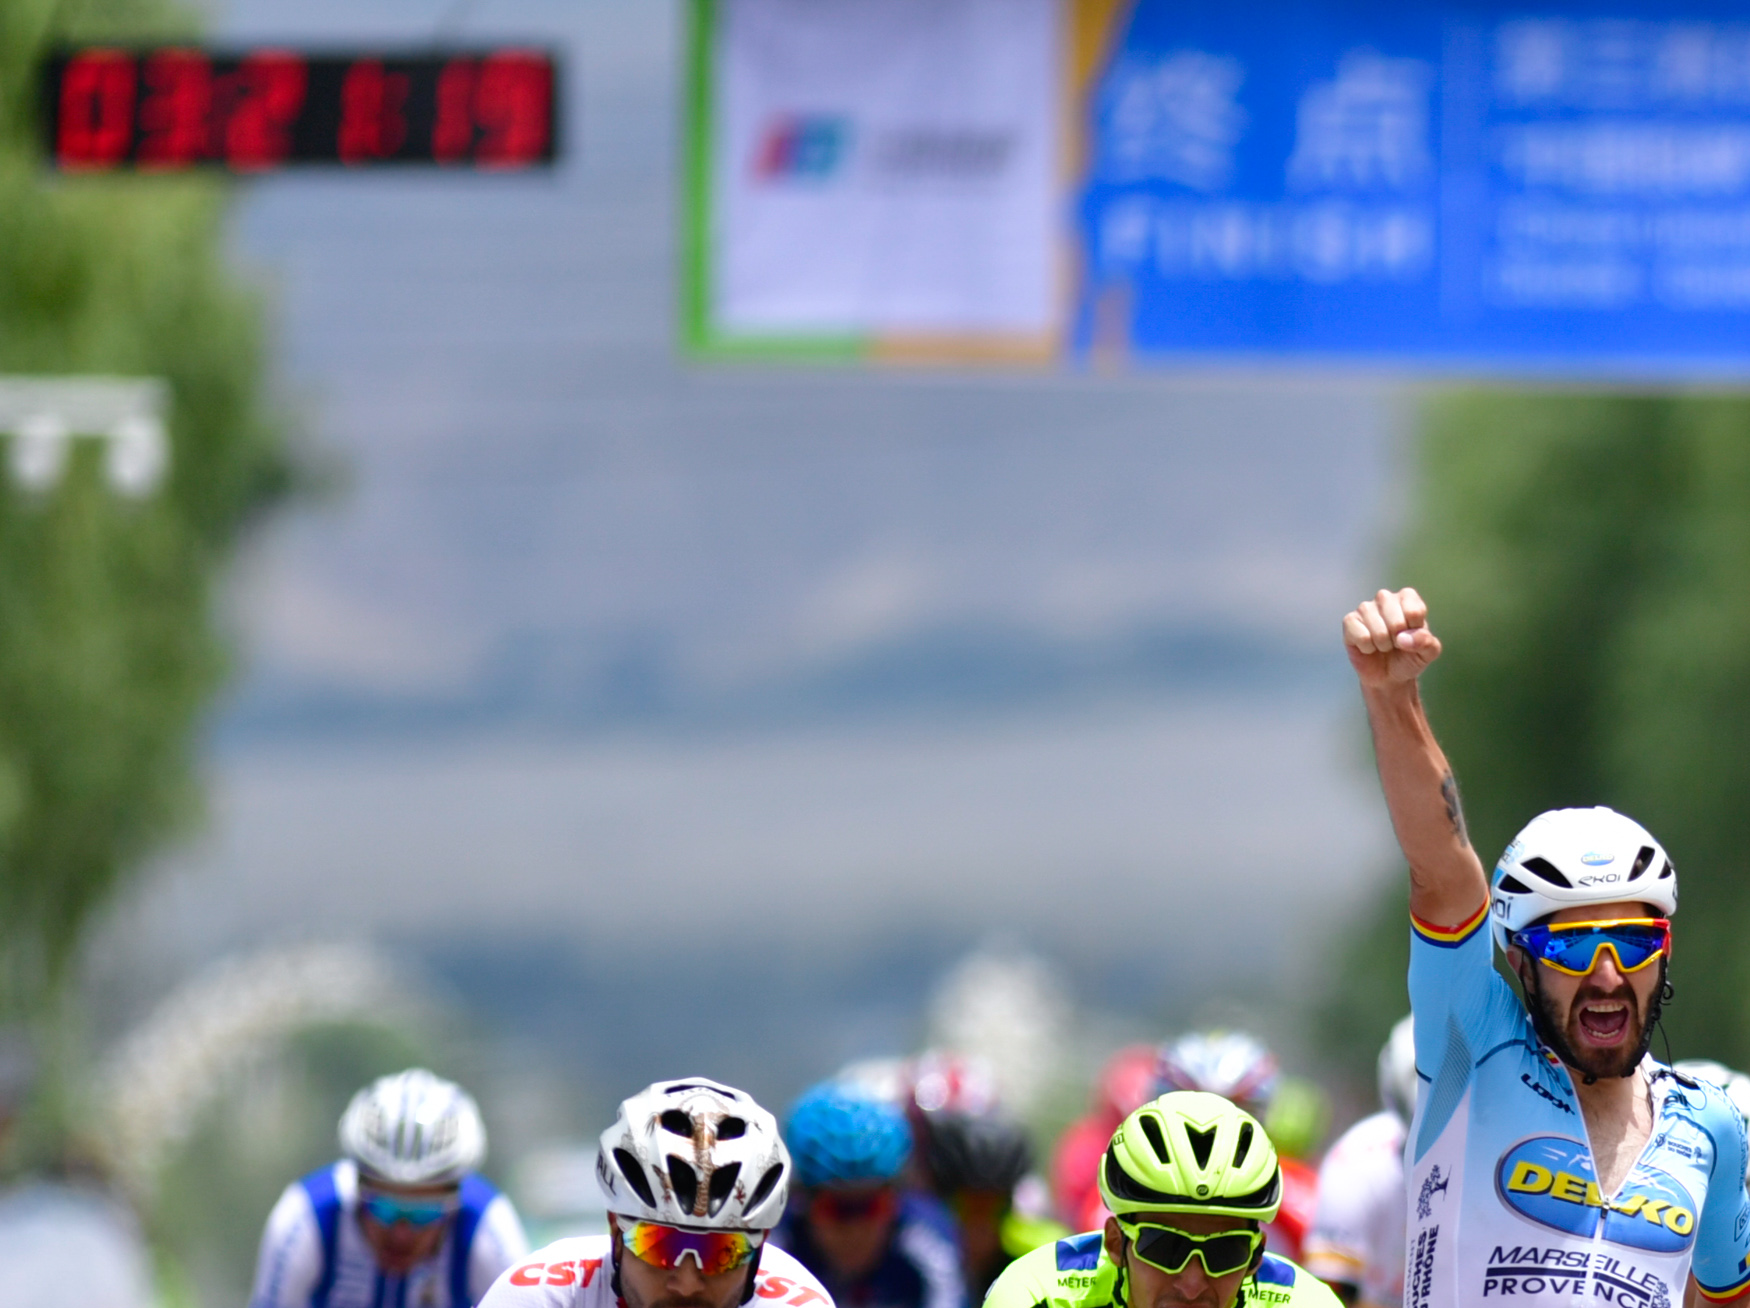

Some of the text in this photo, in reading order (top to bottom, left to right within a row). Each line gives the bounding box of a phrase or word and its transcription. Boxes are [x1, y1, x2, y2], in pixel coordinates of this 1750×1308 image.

[1100, 198, 1436, 282] FINISH
[1507, 1160, 1694, 1236] DELKO
[509, 1258, 604, 1289] CST
[755, 1268, 830, 1308] ST
[1057, 1276, 1098, 1289] METER
[1487, 1246, 1660, 1292] MARSEILLE
[1248, 1287, 1292, 1305] METER
